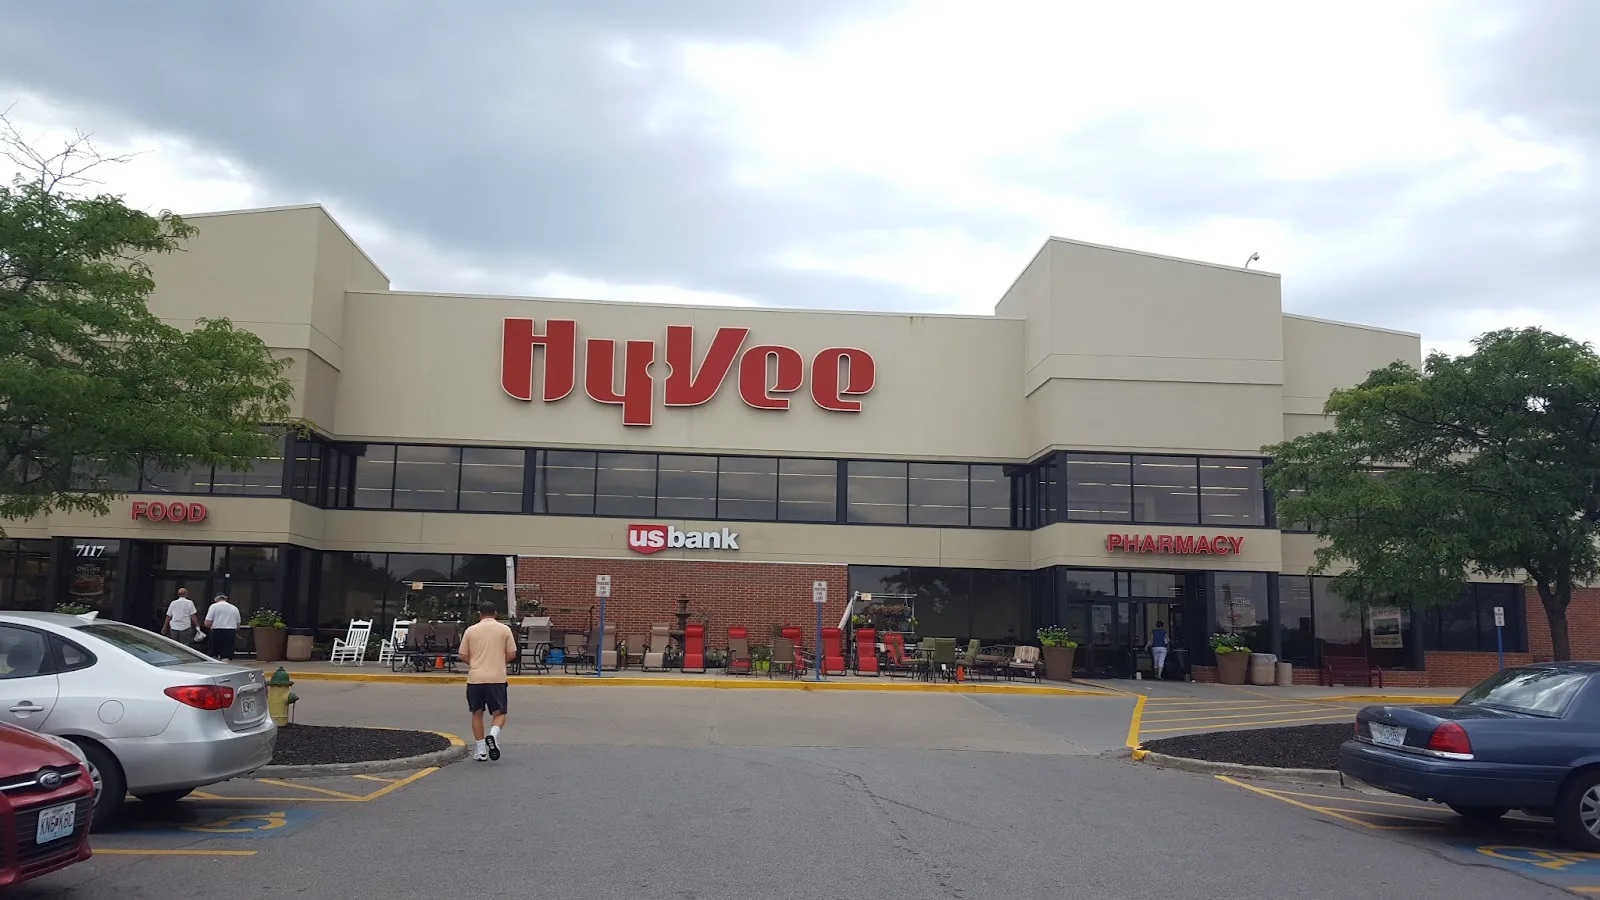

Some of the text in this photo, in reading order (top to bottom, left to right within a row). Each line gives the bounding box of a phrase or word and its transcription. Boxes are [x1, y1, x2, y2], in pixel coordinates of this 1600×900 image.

[131, 501, 207, 522] FOOD
[76, 544, 105, 557] 7117
[1106, 534, 1244, 555] PHARMACY
